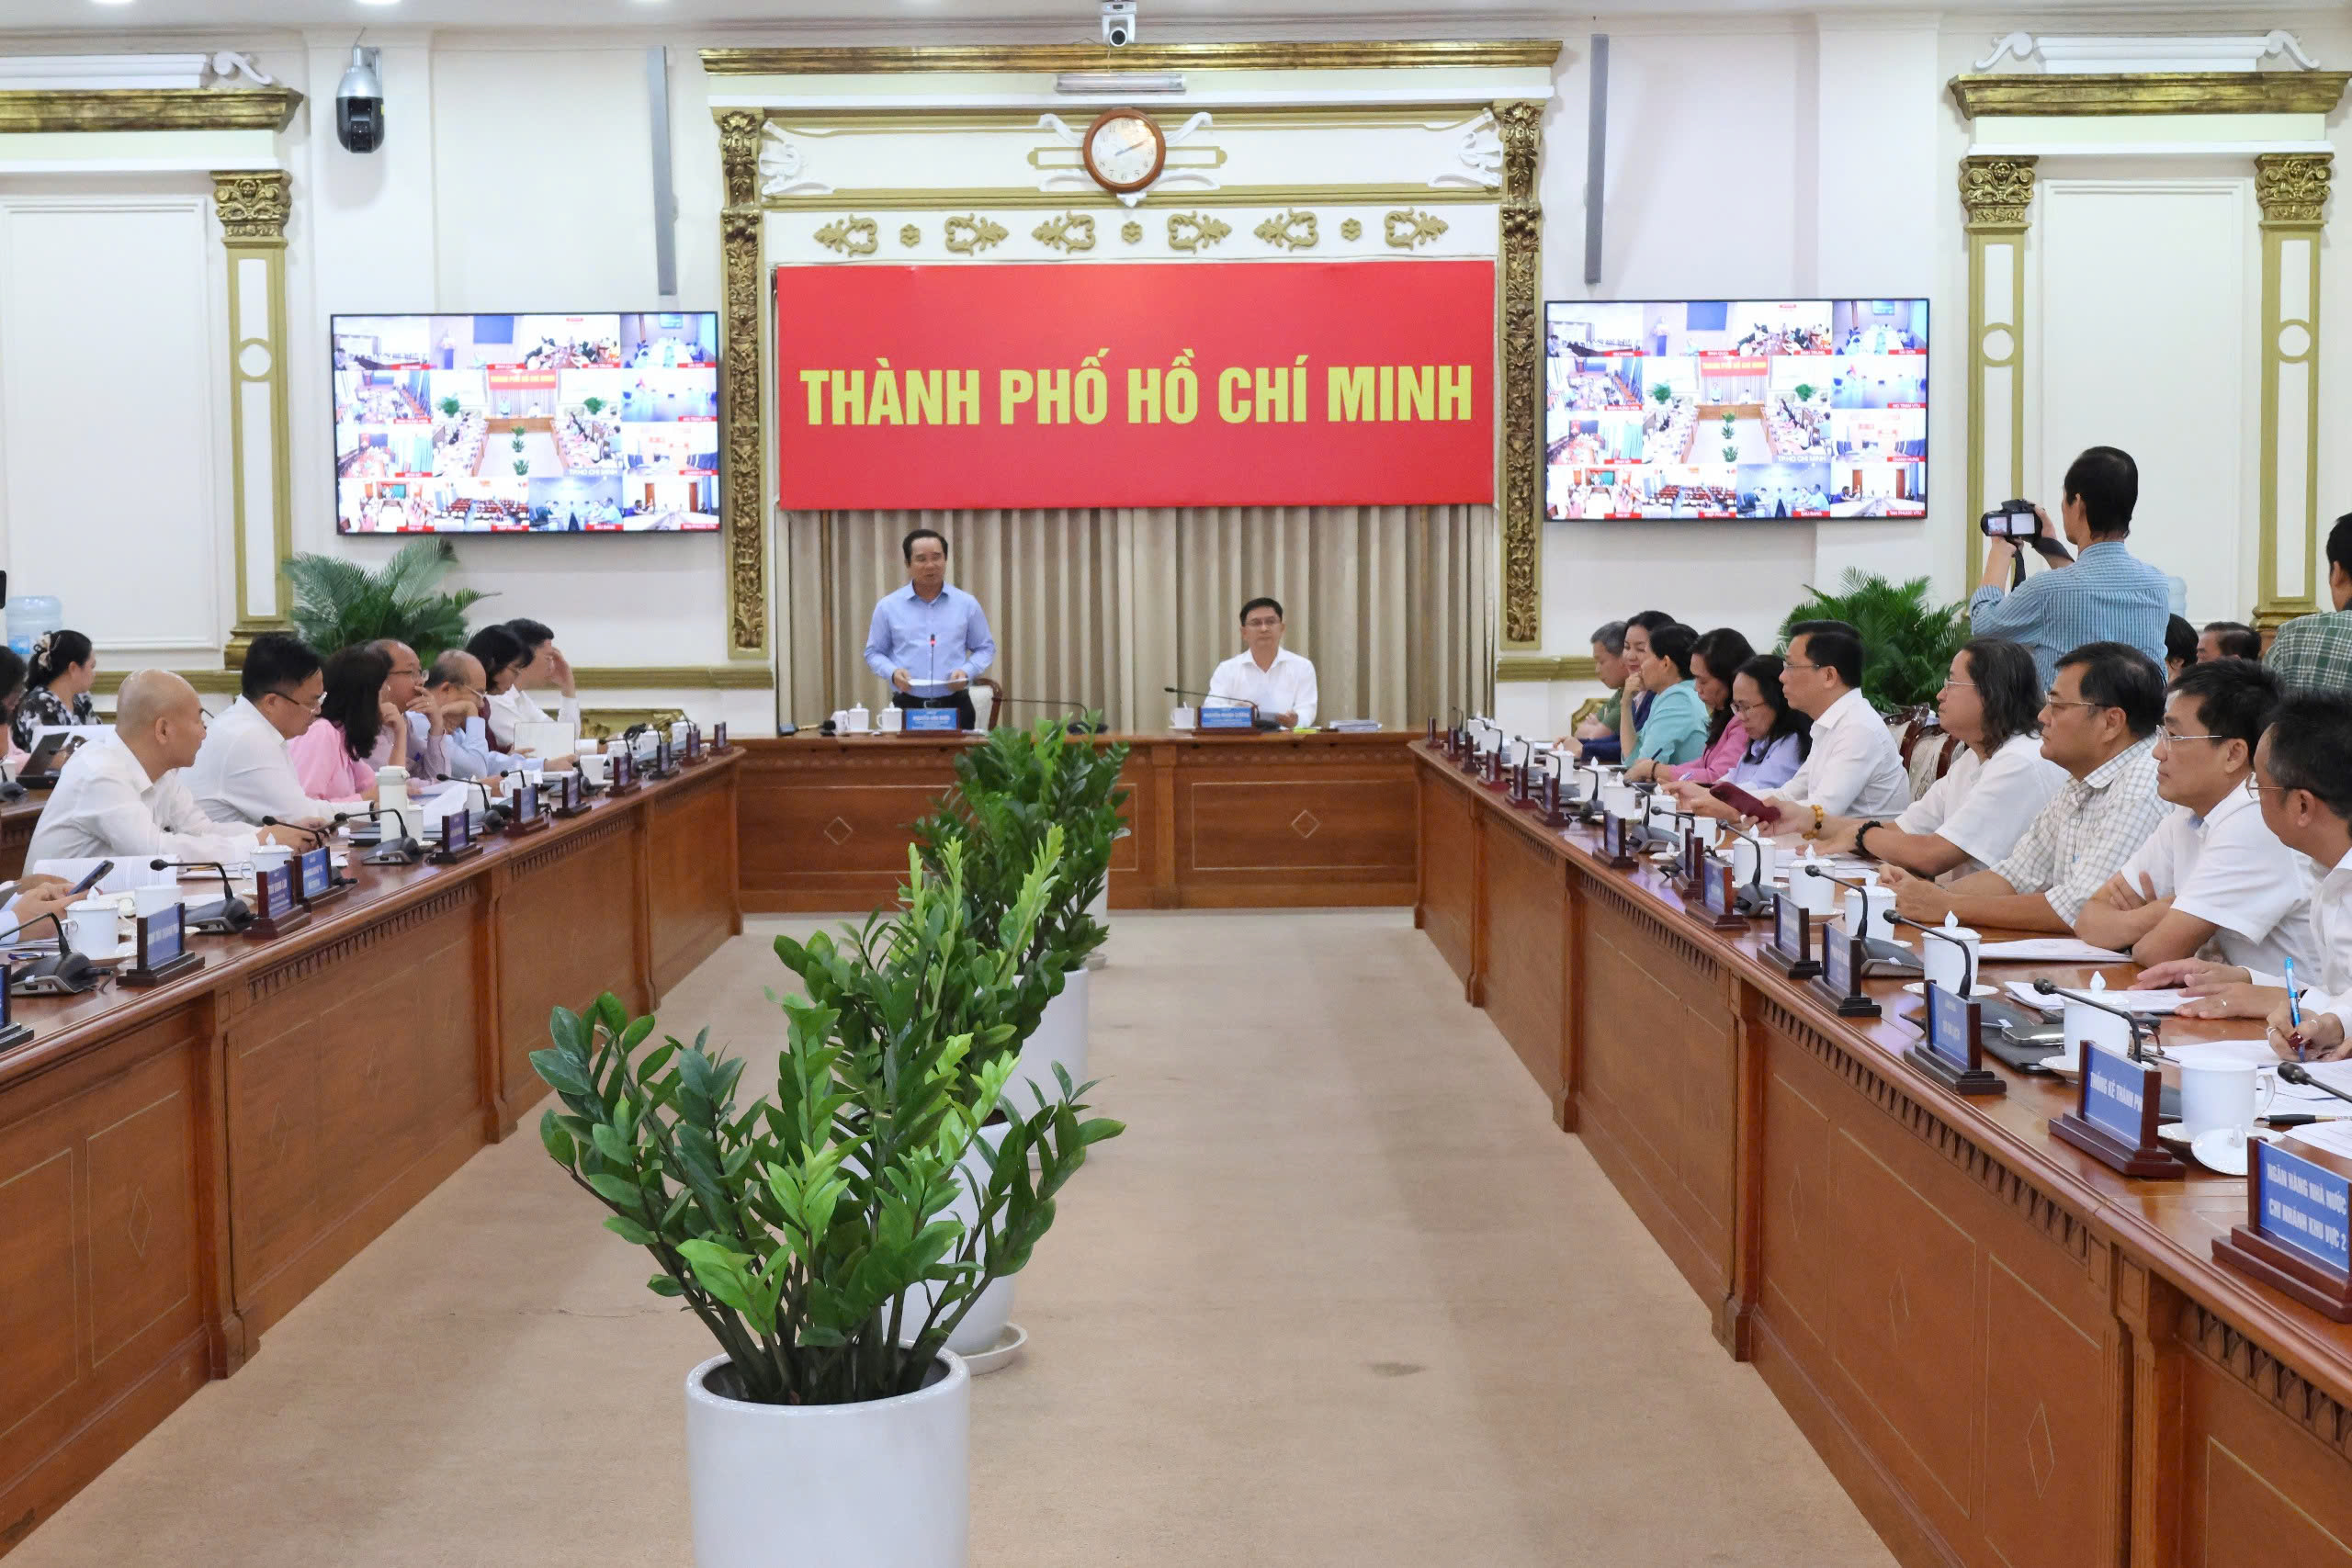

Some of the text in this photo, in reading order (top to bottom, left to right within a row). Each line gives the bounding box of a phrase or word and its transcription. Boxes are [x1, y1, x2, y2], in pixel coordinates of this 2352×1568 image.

[800, 348, 1472, 425] THÀNH PHỐ HỒ CHÍ MINH
[2341, 1233, 2346, 1251] 2
